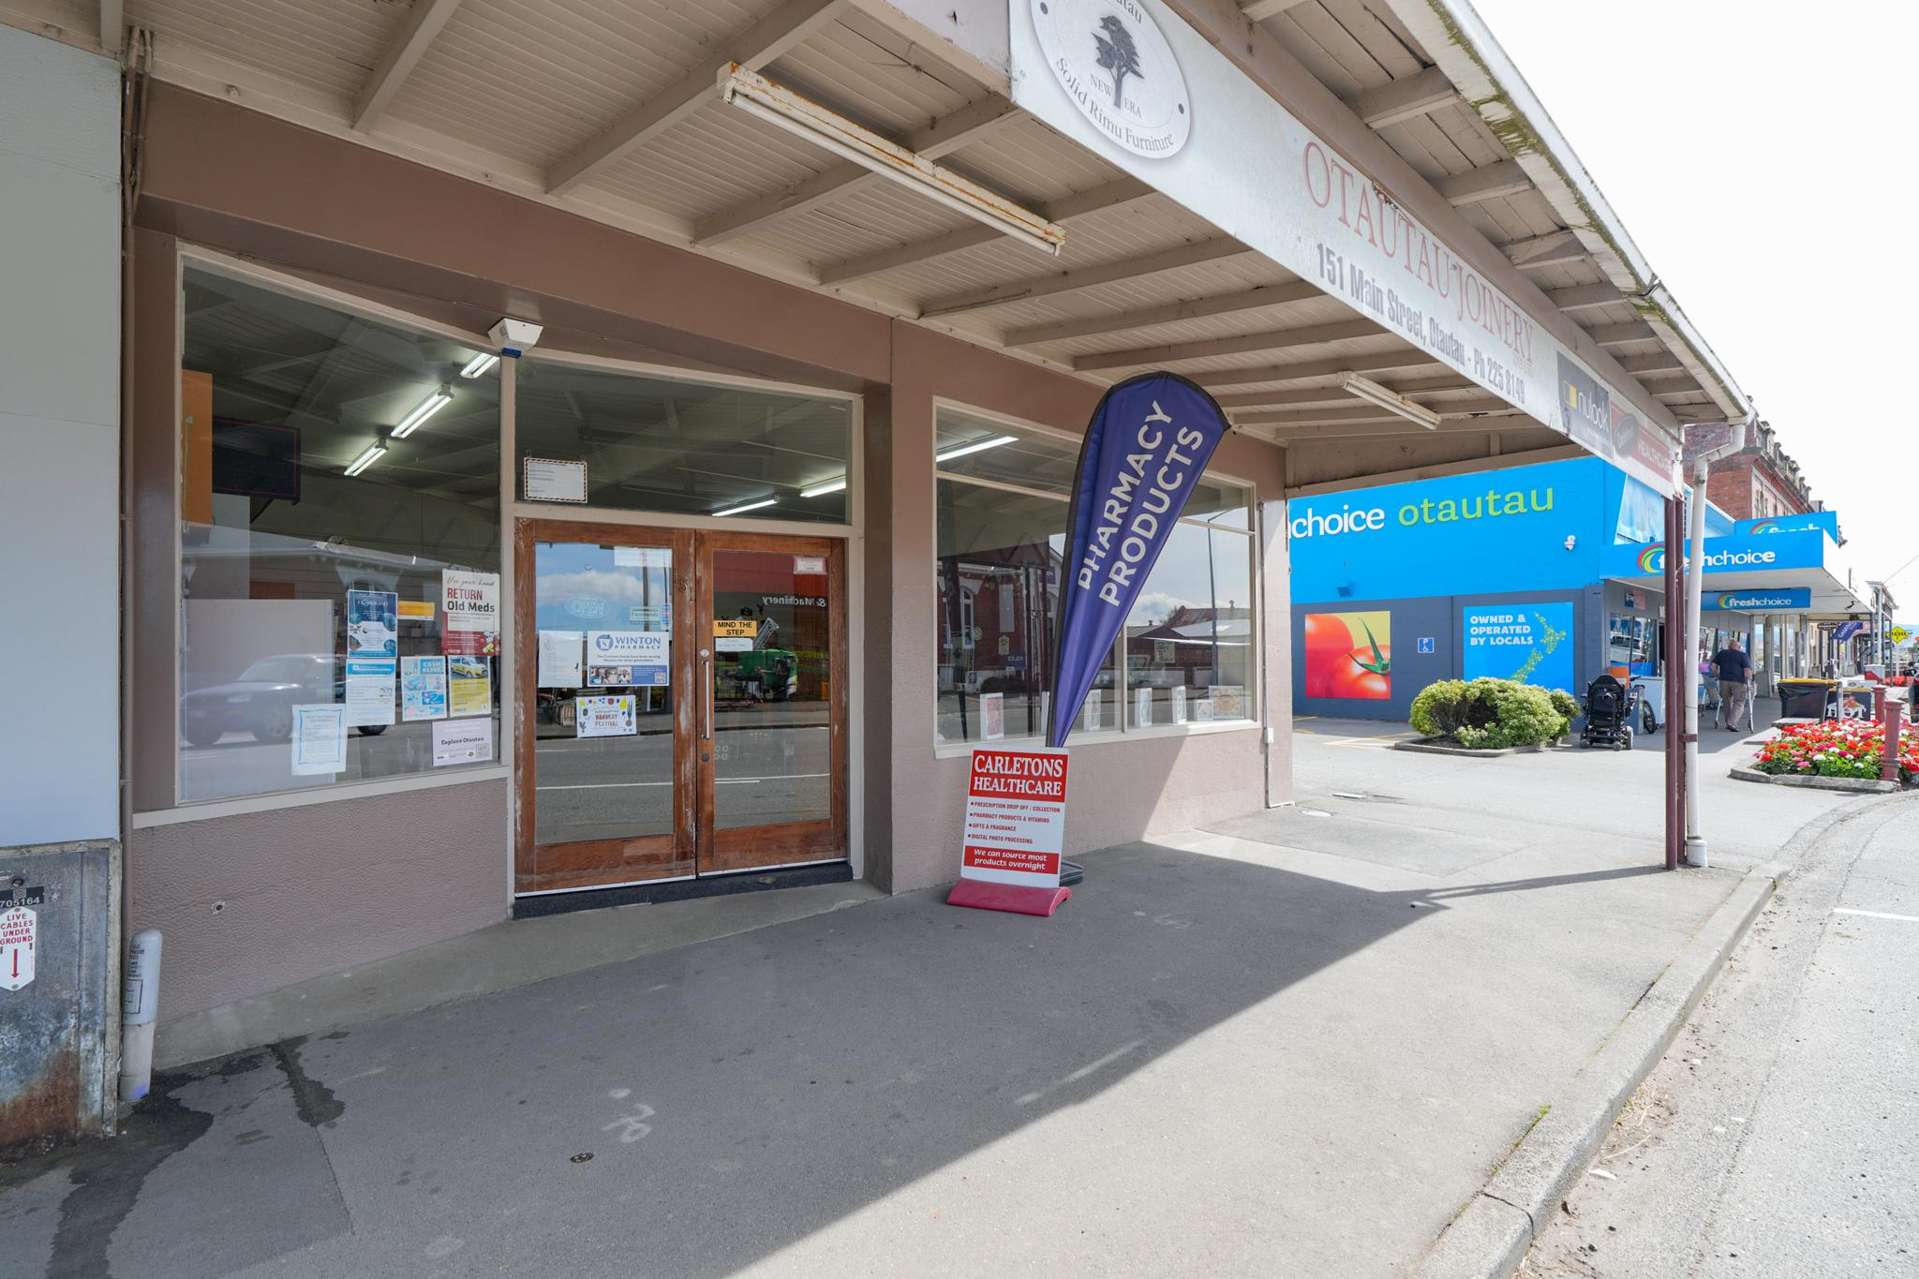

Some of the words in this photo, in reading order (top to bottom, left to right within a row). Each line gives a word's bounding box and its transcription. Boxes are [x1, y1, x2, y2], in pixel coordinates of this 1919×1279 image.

[1090, 74, 1113, 97] NEW
[1124, 97, 1142, 118] ERA
[1056, 57, 1087, 105] Solid
[1090, 106, 1122, 138] Rimu
[1126, 127, 1174, 151] Furniture
[1304, 141, 1454, 298] OTAUTAU
[1455, 262, 1536, 363] JOINERY
[1317, 242, 1344, 291] 151
[1351, 264, 1383, 315] Main
[1387, 287, 1426, 344] Street,
[1474, 347, 1485, 379] Ph
[1078, 400, 1172, 590] PHARMACY
[1398, 486, 1554, 527] otautau
[1099, 426, 1203, 606] PRODUCTS
[447, 587, 483, 600] RETURN
[447, 601, 465, 611] Old
[468, 602, 495, 612] Meds
[1729, 596, 1792, 607] freshchoice
[739, 621, 753, 629] THE
[1470, 615, 1514, 624] OWNED
[1517, 614, 1526, 623] &
[1470, 625, 1531, 635] OPERATED
[614, 636, 661, 645] WINTON
[1470, 637, 1486, 646] BY
[1490, 636, 1534, 645] LOCALS
[974, 755, 1063, 777] CARLETONS
[973, 776, 1062, 796] HEALTHCARE
[974, 848, 986, 856] We
[1002, 852, 1026, 860] source
[1028, 854, 1047, 862] most
[974, 858, 1007, 867] products
[1008, 861, 1046, 871] overnight
[7, 913, 27, 921] LIVE
[0, 920, 33, 930] CABLES
[3, 928, 31, 937] UNDER
[0, 936, 33, 946] GROUND
